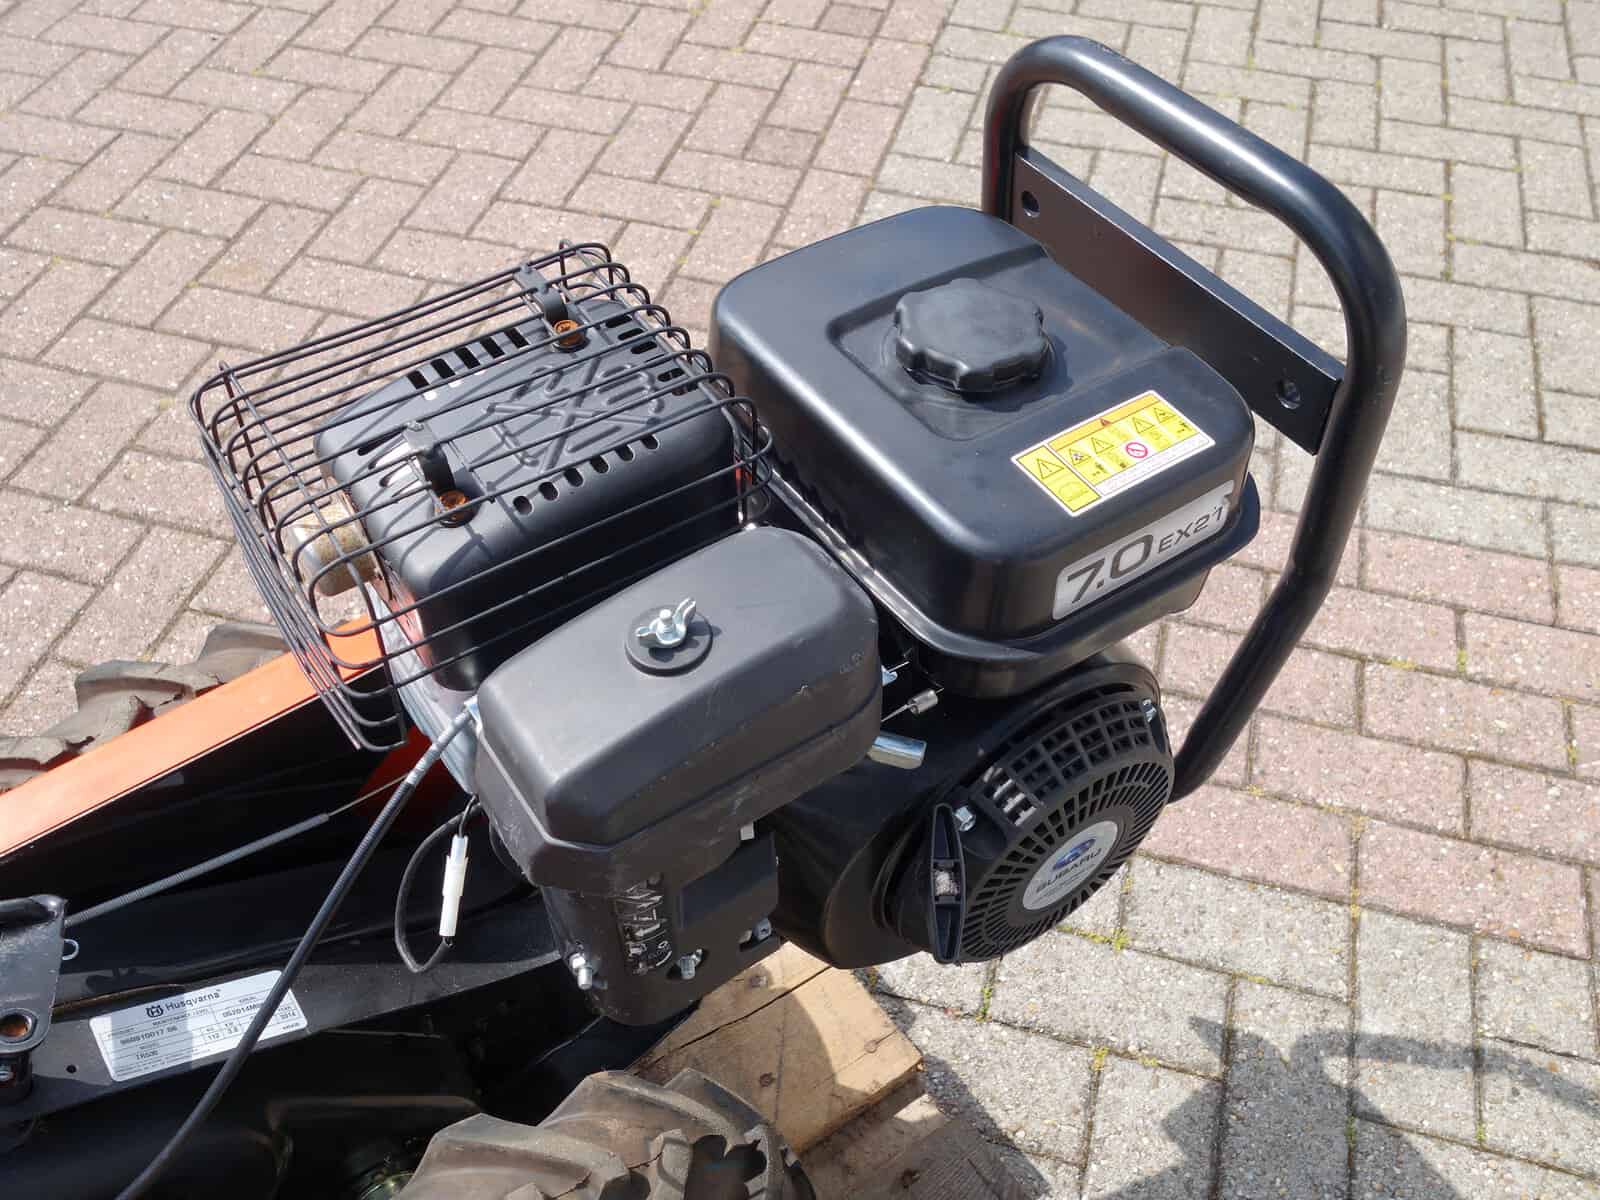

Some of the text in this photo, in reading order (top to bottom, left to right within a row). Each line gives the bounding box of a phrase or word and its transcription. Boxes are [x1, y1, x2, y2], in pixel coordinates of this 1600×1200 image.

[1067, 505, 1224, 604] 7.0 EX21
[1036, 847, 1102, 893] SUBARU
[165, 991, 221, 1012] Husqvarna
